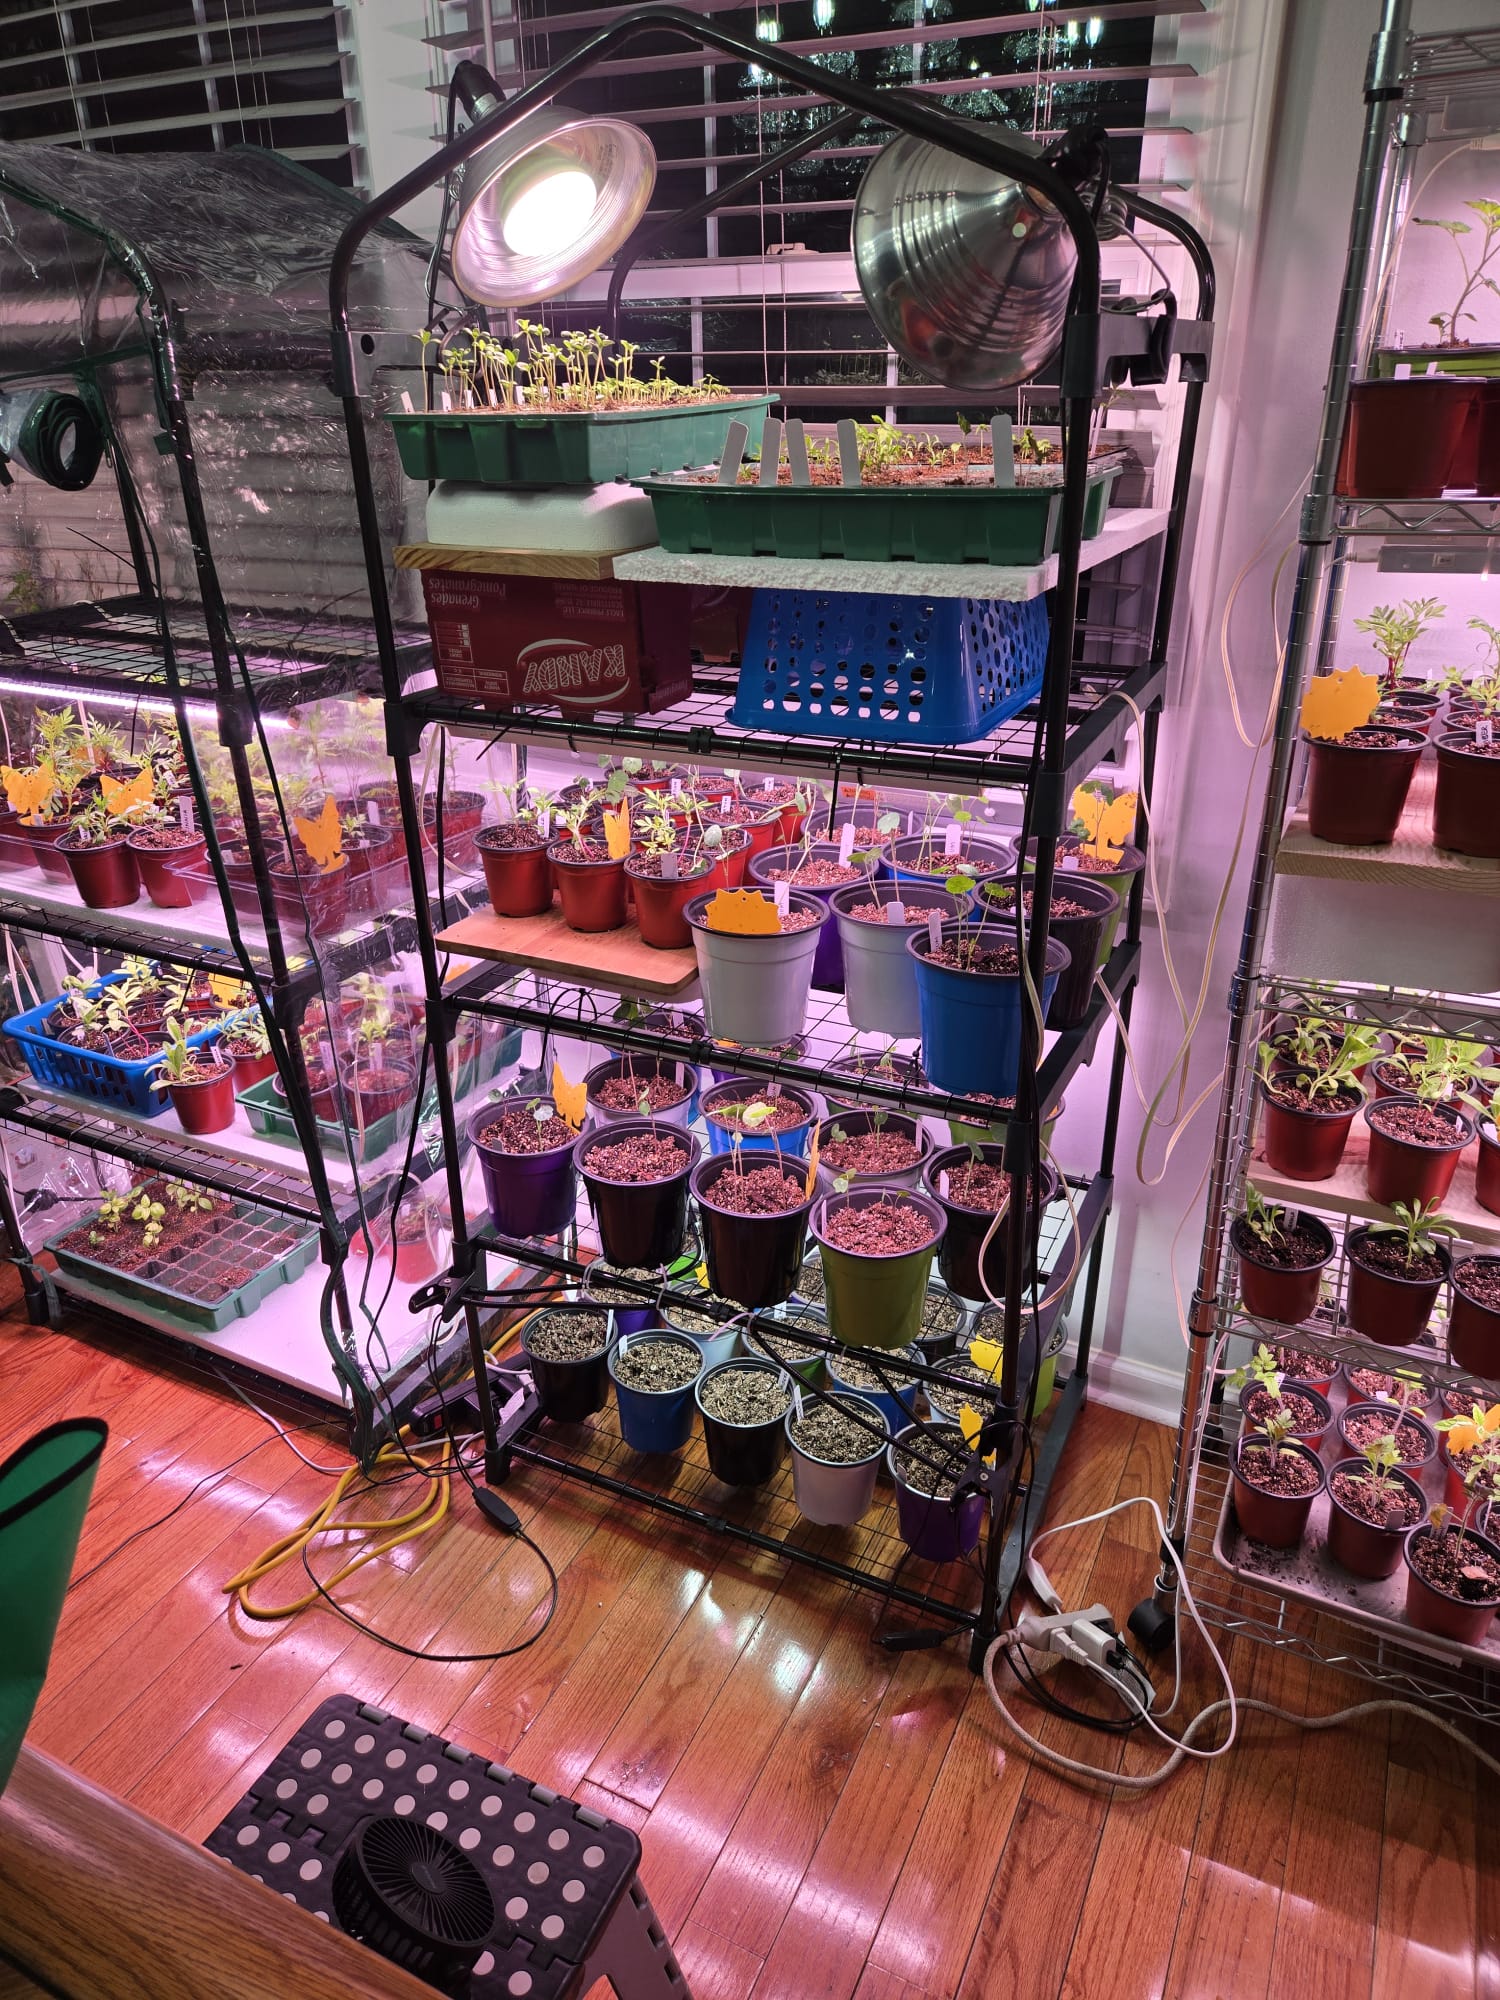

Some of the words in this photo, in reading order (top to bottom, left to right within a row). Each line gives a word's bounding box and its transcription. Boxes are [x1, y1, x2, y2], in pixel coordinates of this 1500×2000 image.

[428, 578, 507, 599] Pomegranates
[431, 592, 479, 608] Grenades
[522, 644, 626, 693] KANDY
